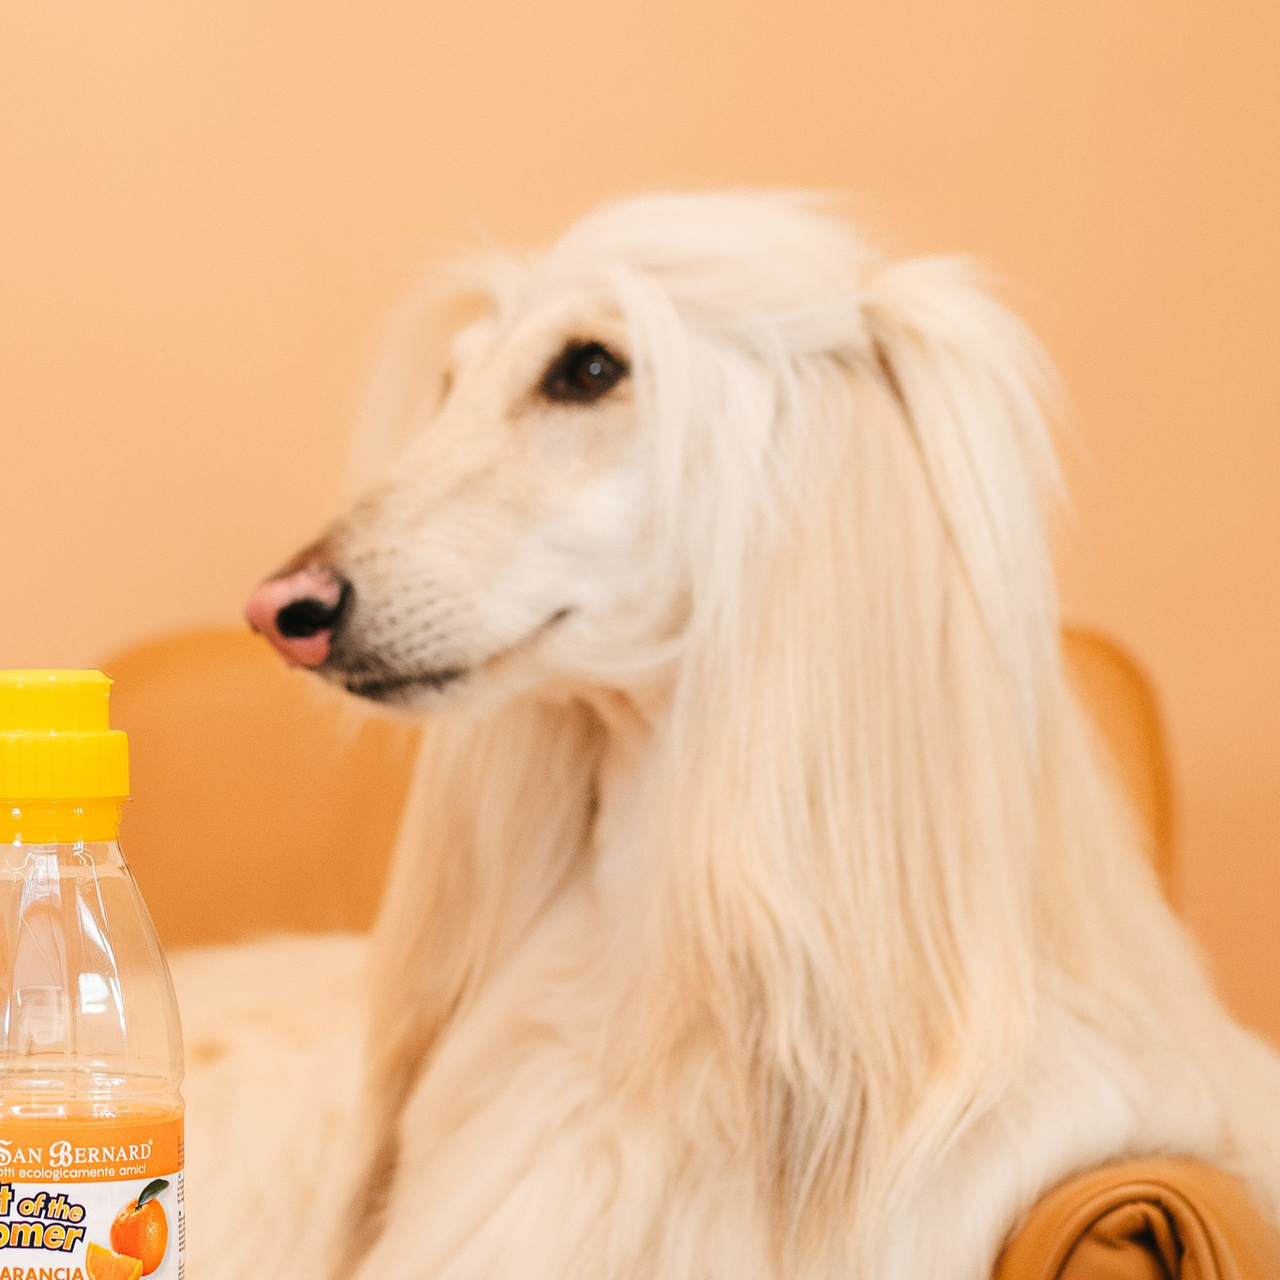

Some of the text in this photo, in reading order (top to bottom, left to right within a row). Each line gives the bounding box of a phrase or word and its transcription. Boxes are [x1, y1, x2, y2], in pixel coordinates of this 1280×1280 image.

[19, 1167, 114, 1181] ecologicamente
[119, 1164, 146, 1175] amici
[17, 1192, 48, 1217] of
[45, 1194, 86, 1223] the
